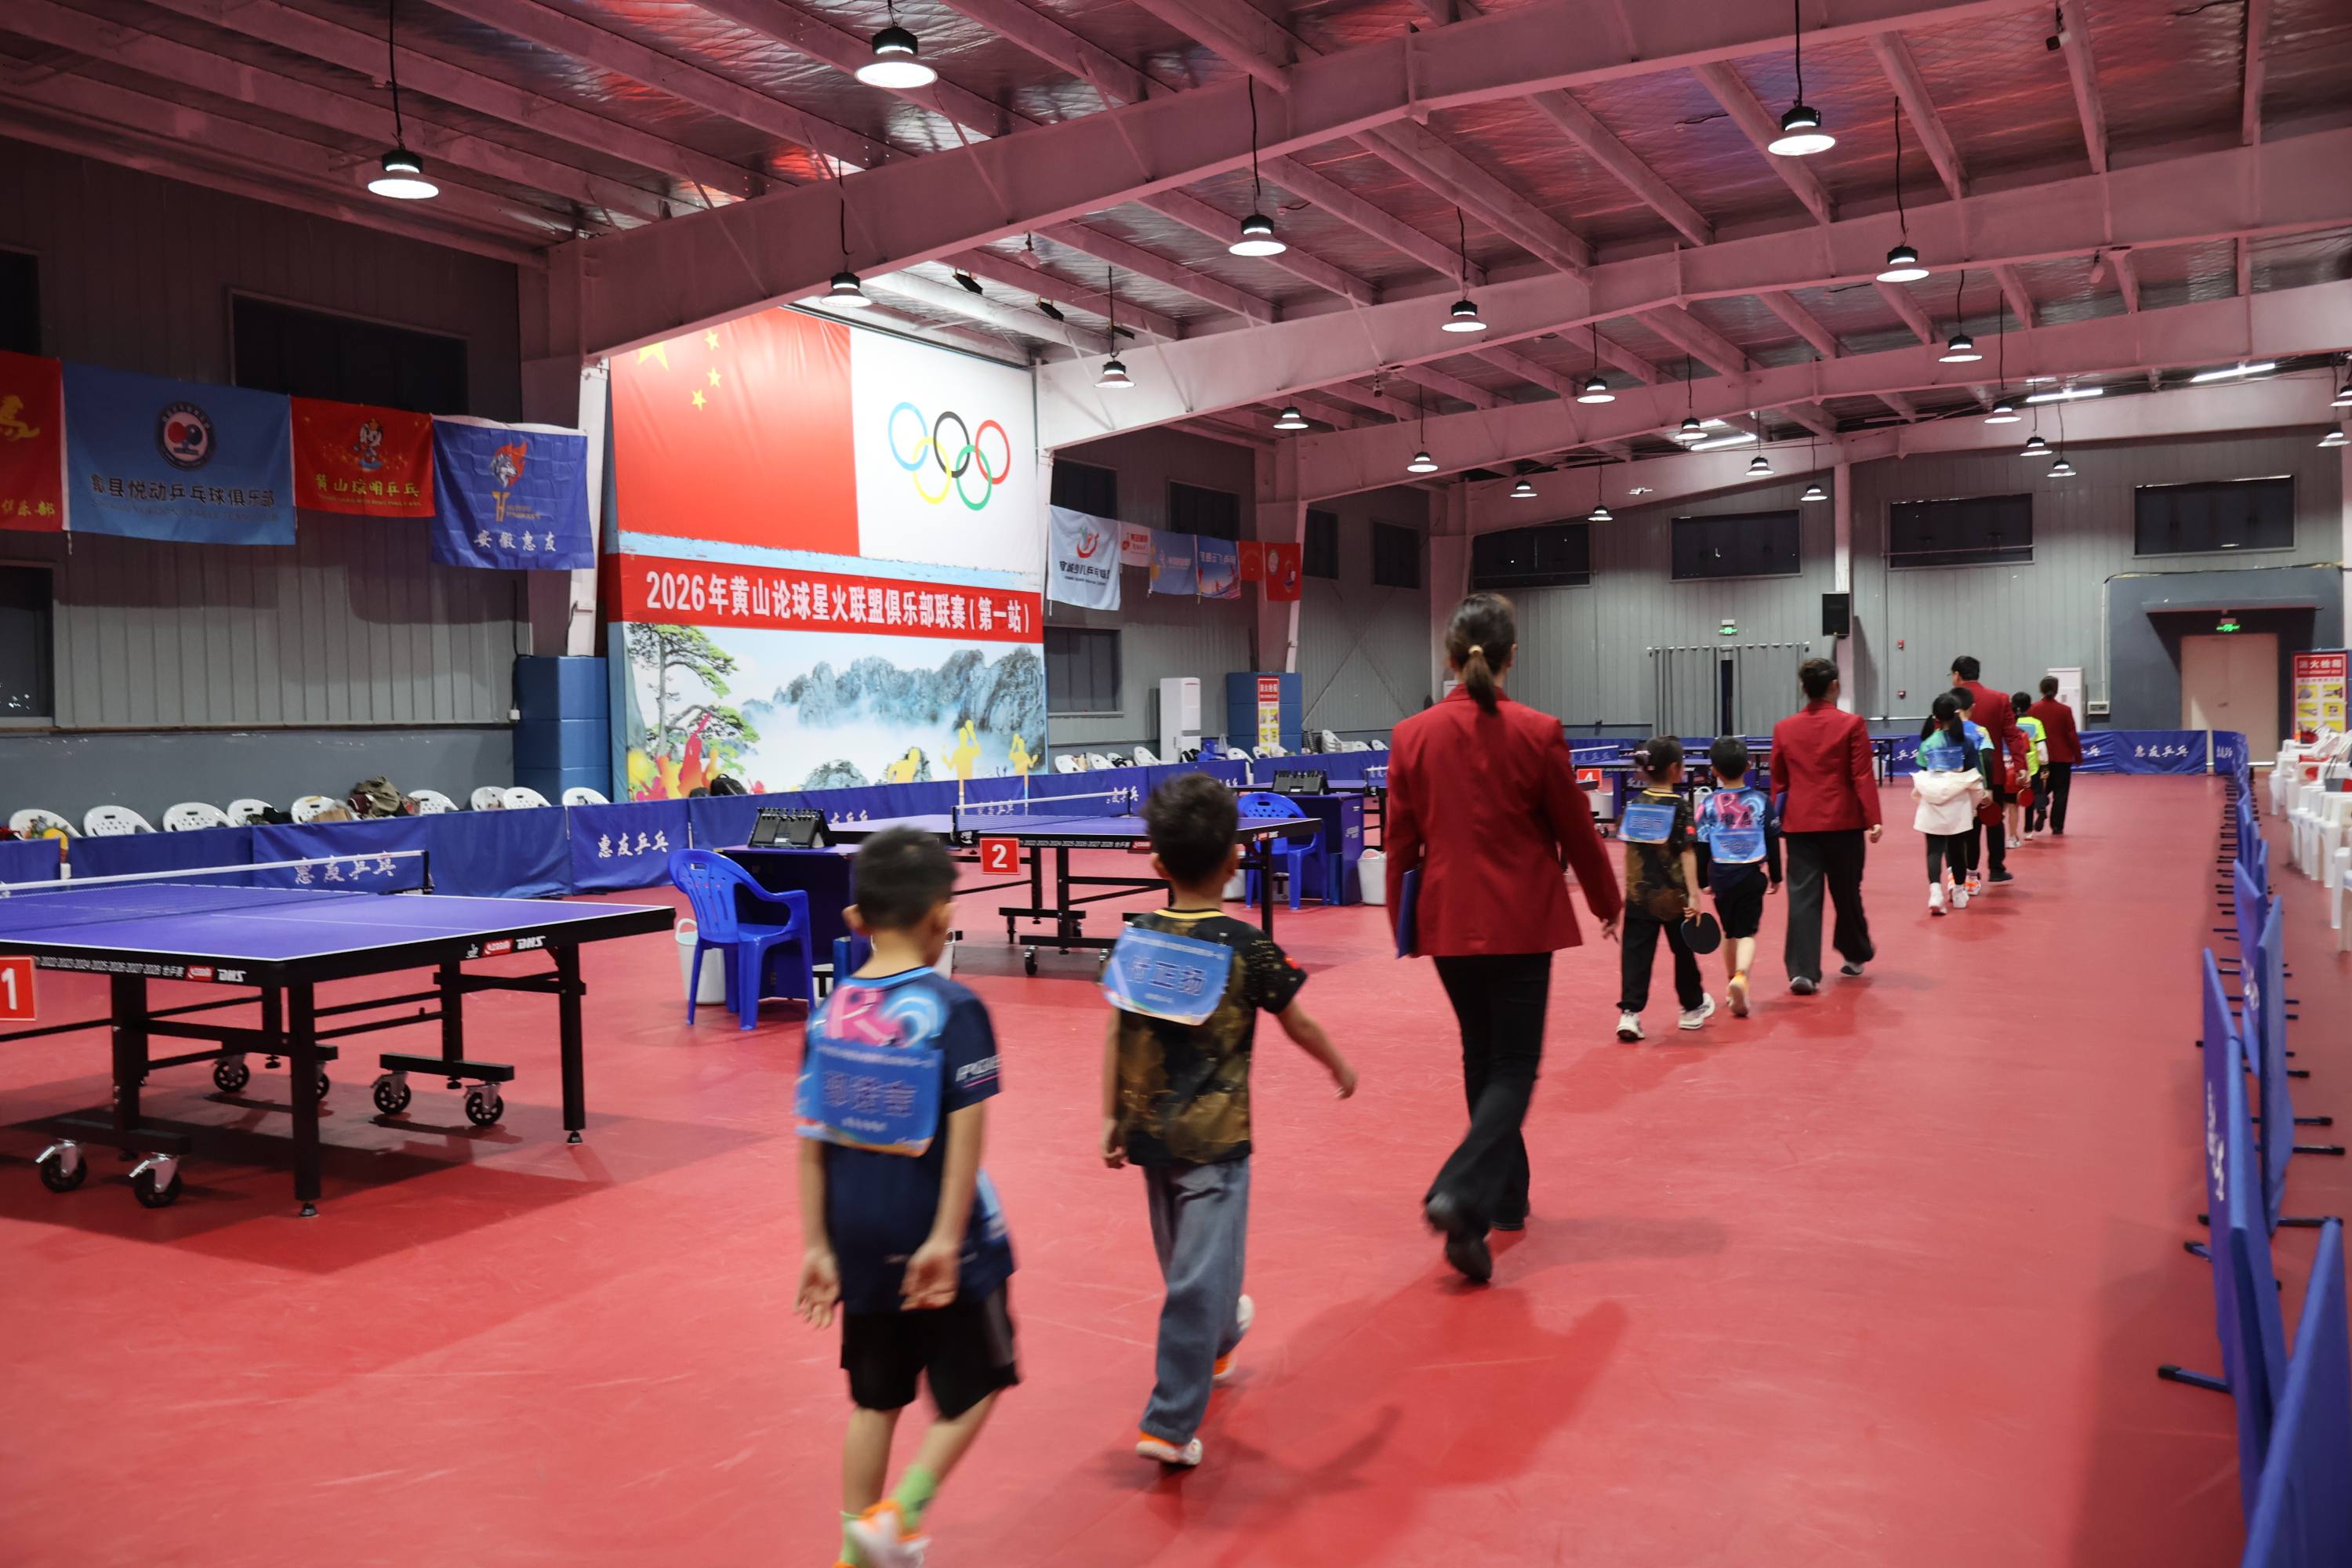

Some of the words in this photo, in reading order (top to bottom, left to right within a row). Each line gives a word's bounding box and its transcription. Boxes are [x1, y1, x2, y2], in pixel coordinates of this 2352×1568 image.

[646, 571, 1029, 633] 2026年黄山论球星火联盟俱乐部联赛（第一站）
[597, 829, 670, 858] 惠友乒乓
[991, 844, 1008, 869] 2
[515, 935, 546, 950] DHS
[2, 967, 17, 1011] 1
